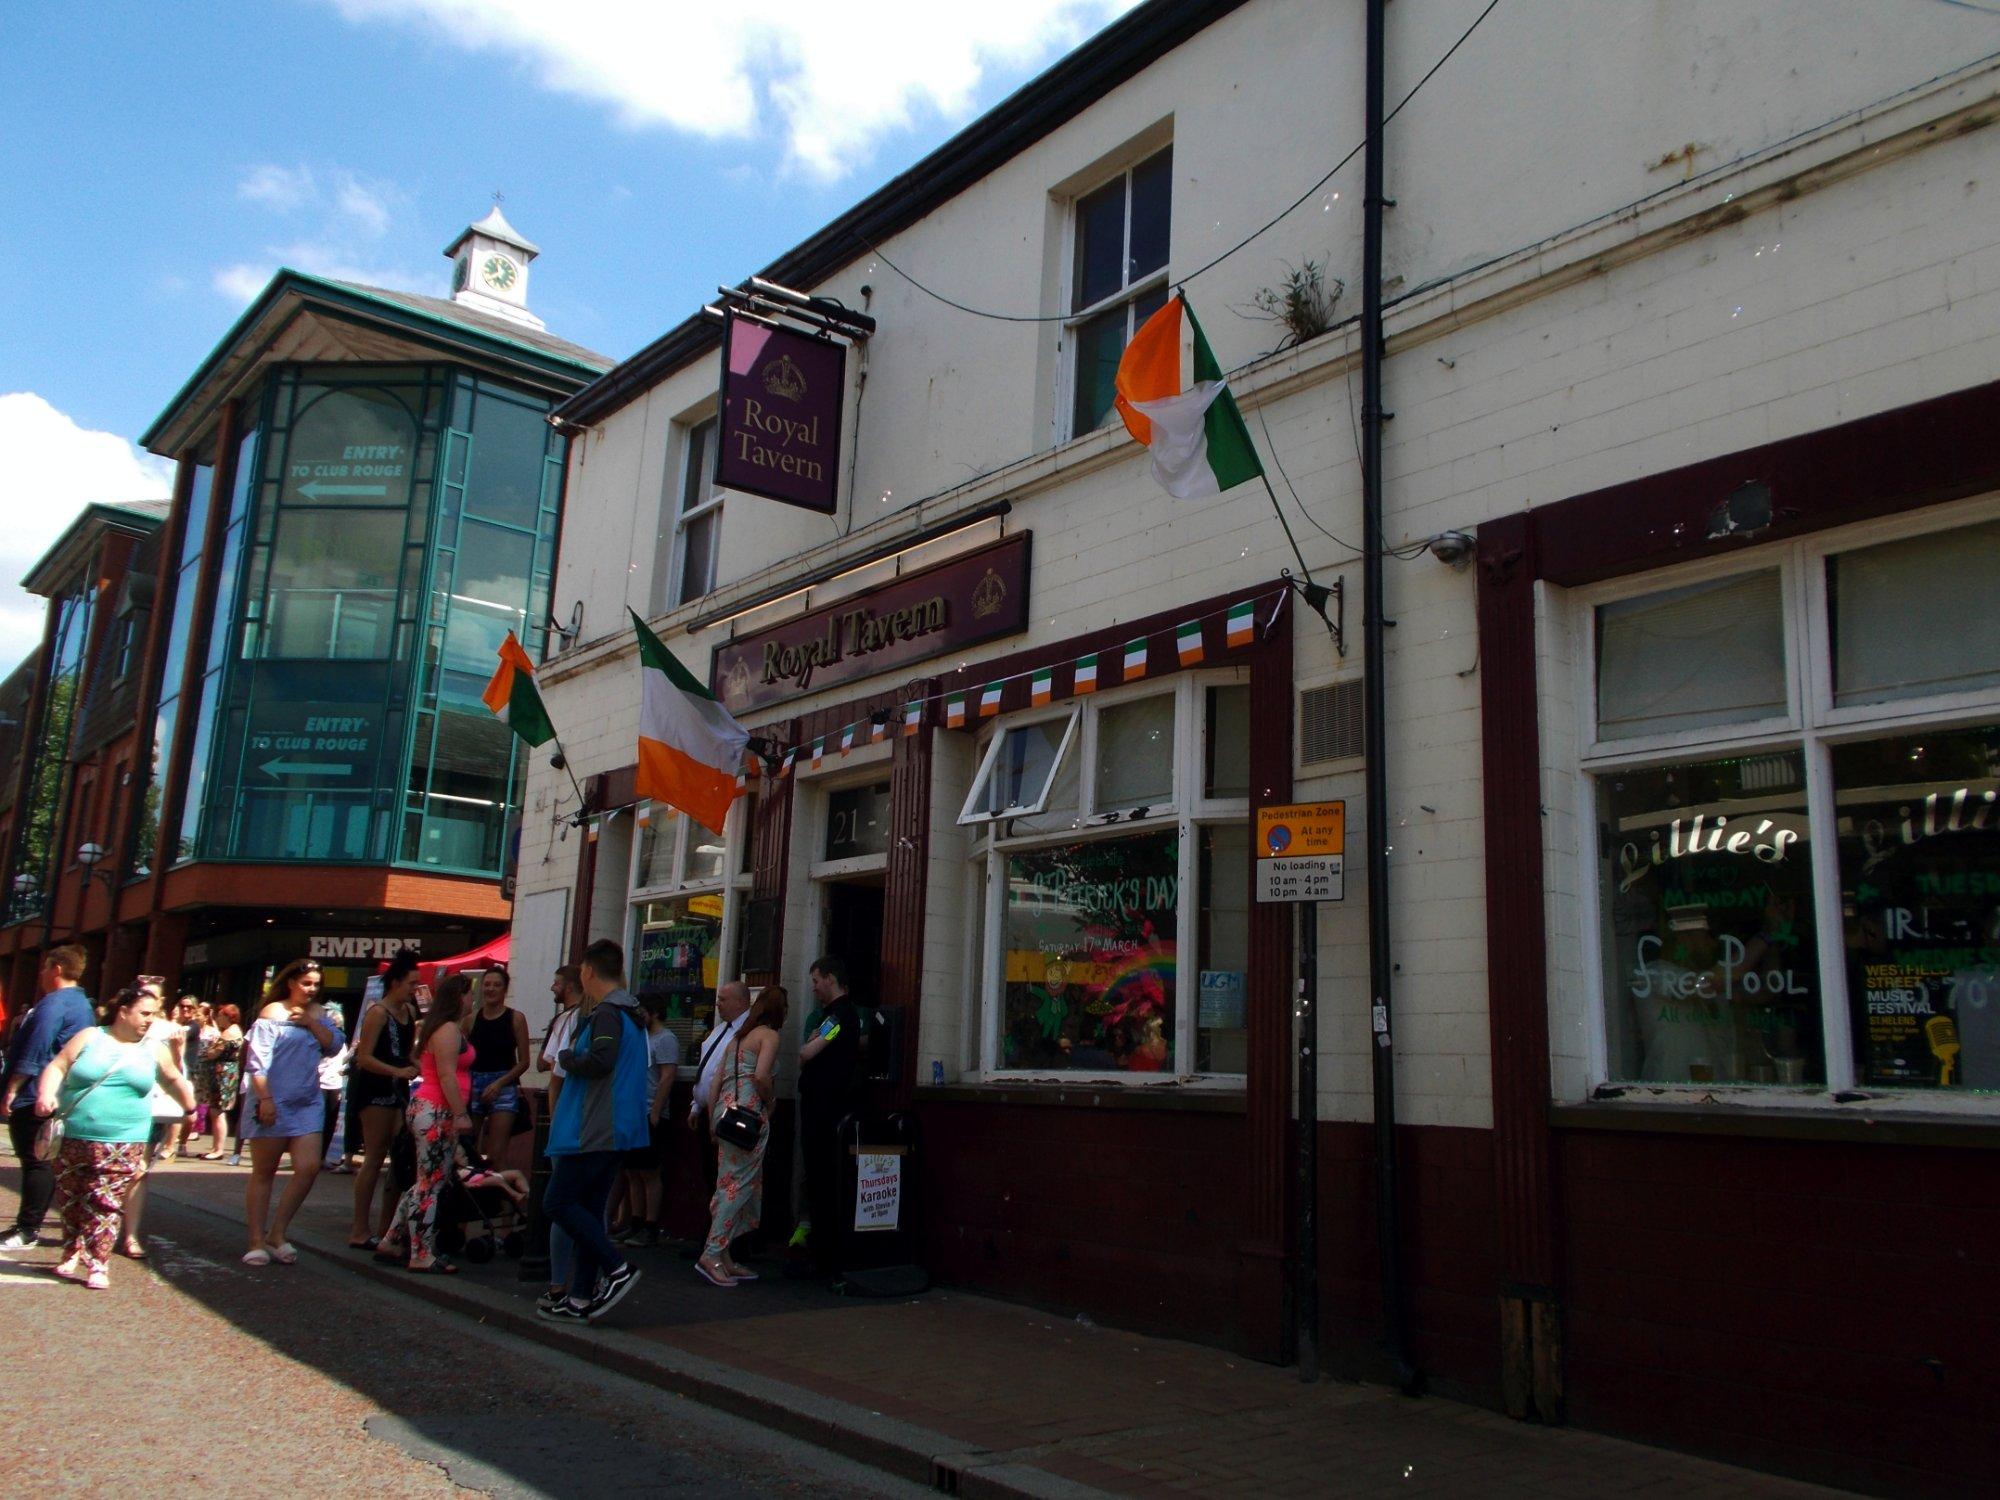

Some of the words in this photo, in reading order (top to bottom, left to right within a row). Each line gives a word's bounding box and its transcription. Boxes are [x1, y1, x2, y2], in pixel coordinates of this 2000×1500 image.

[742, 397, 820, 448] Royal
[342, 445, 401, 460] ENTRY
[734, 430, 823, 482] Tavern
[291, 465, 310, 477] TO
[314, 465, 349, 477] CLUB
[352, 465, 403, 477] ROUGE
[760, 614, 839, 689] Royal
[843, 596, 947, 657] Tavern
[304, 717, 366, 733] ENTRY
[251, 736, 272, 750] TO
[275, 737, 312, 750] CLUB
[315, 738, 369, 751] ROUGE
[1261, 809, 1313, 820] Pedestrian
[1316, 807, 1340, 817] Zone
[833, 808, 857, 845] 21
[1301, 826, 1313, 836] At
[1316, 826, 1334, 837] any
[1862, 788, 2000, 876] Lilli
[1306, 837, 1329, 847] time
[1620, 813, 1798, 894] Lillie's
[1273, 862, 1287, 871] No
[1290, 861, 1326, 871] loading
[1270, 877, 1281, 886] 10
[1283, 877, 1297, 885] am
[1304, 875, 1311, 884] 4
[1313, 875, 1329, 885] pm
[1146, 876, 1178, 911] DAY
[1270, 888, 1281, 897] 10
[1283, 888, 1297, 898] pm
[1305, 886, 1312, 896] 4
[1314, 887, 1329, 896] am
[310, 936, 422, 959] EMPIRE
[1102, 938, 1138, 952] MARCH
[1718, 934, 1809, 1000] POOL
[1866, 976, 1922, 989] STREET
[1867, 989, 1915, 1002] MUSIC
[1867, 1002, 1937, 1015] FESTIVAL
[861, 1174, 898, 1189] Thursdays
[860, 1187, 897, 1204] Karaoke
